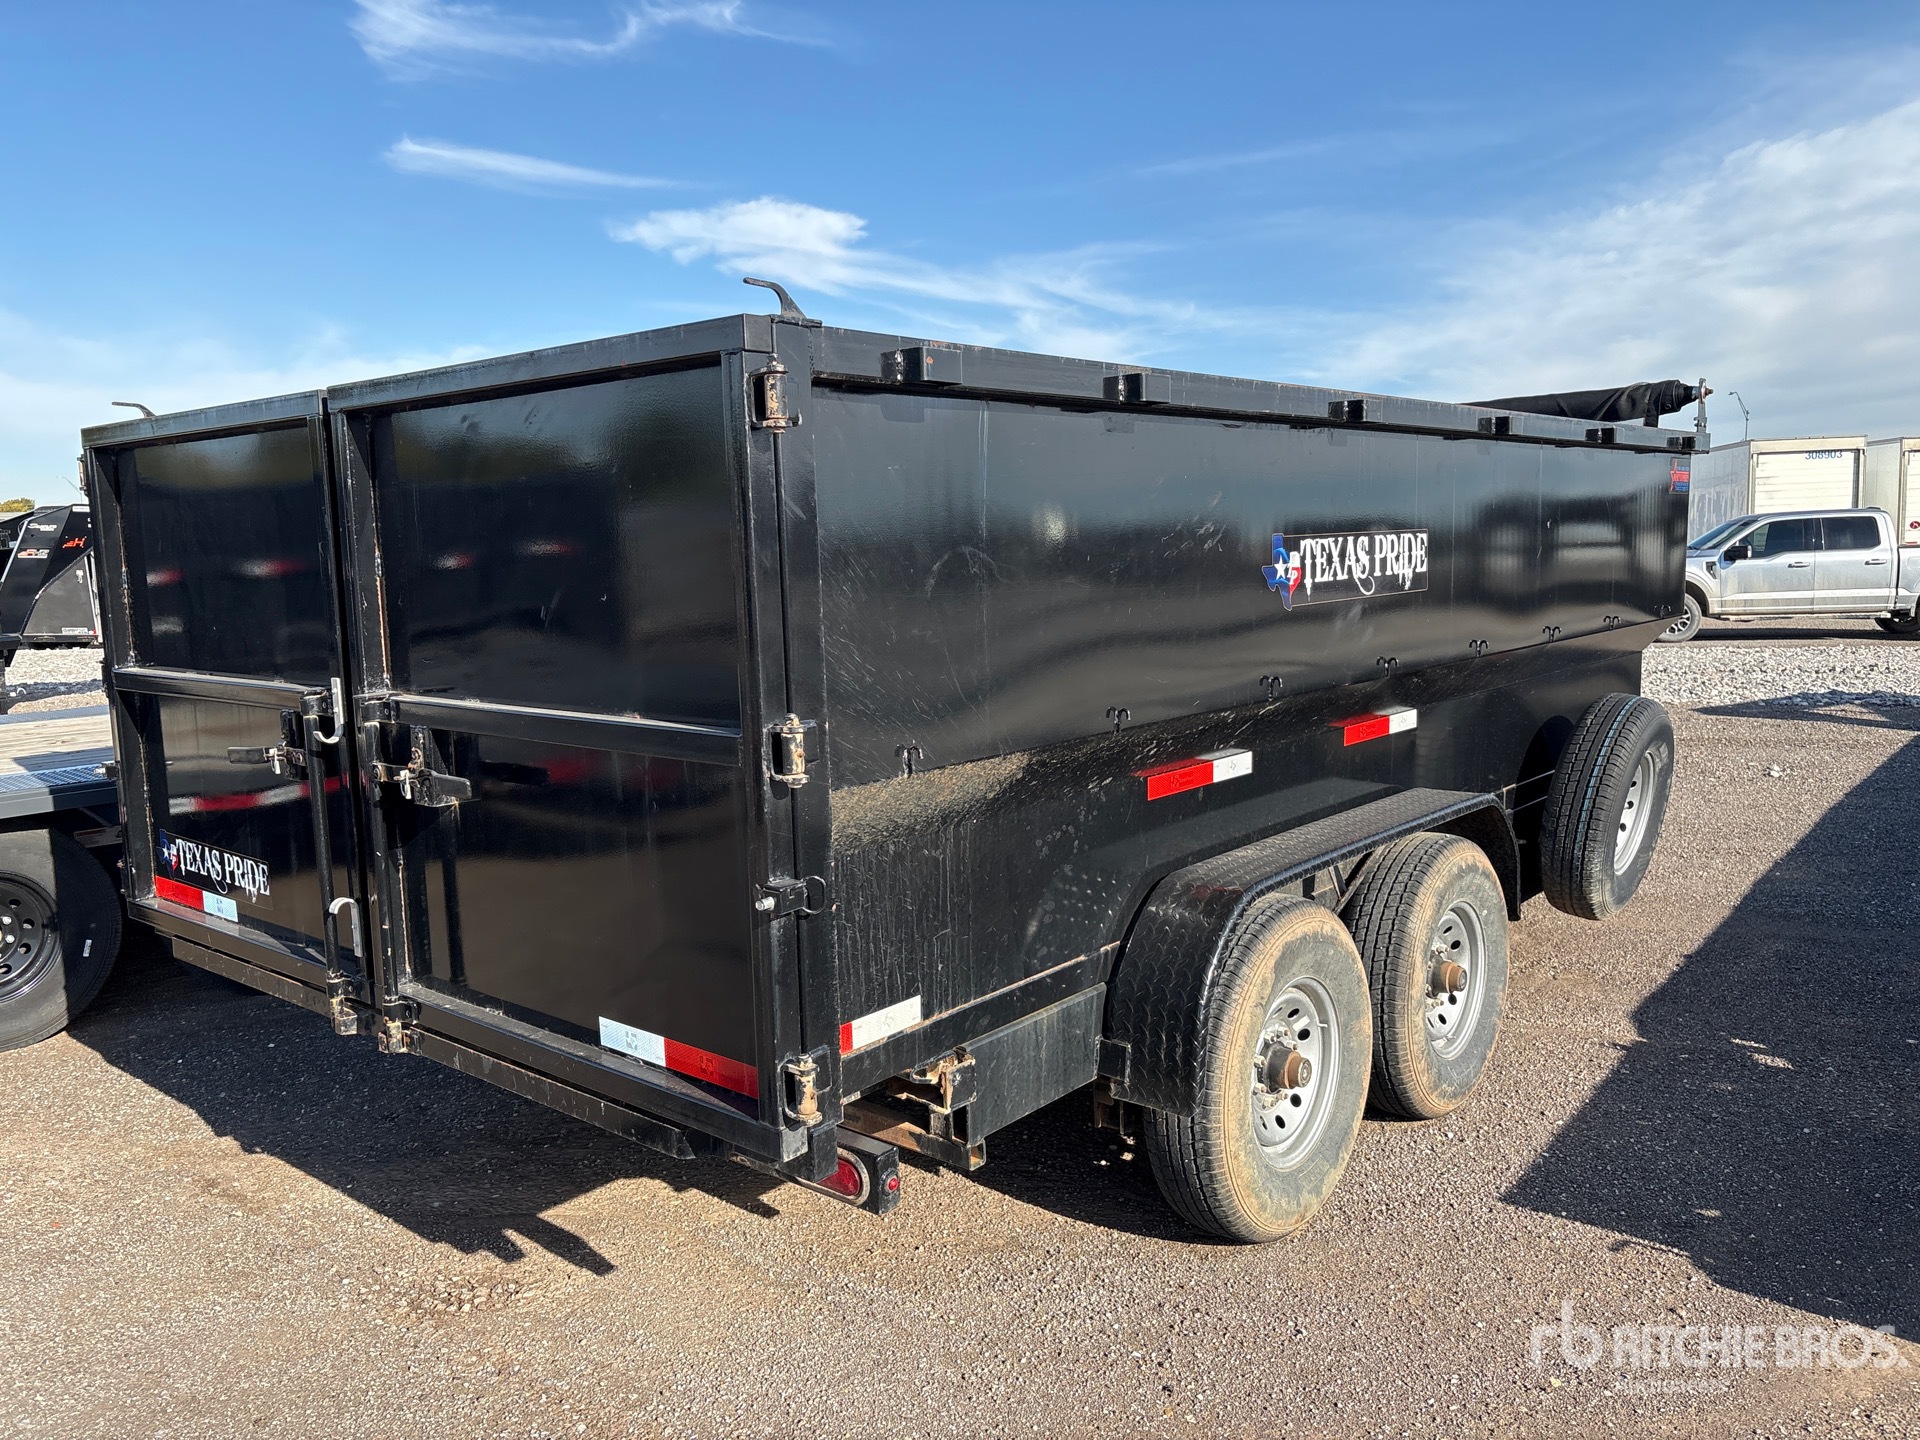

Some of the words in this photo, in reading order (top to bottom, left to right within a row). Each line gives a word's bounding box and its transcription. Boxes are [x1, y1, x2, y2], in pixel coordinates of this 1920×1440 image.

[1805, 450, 1843, 459] 308903
[1299, 535, 1376, 596] TEXAS
[1374, 532, 1428, 590] PRIDE
[175, 838, 228, 894] TEXAS
[223, 852, 270, 904] PRIDE
